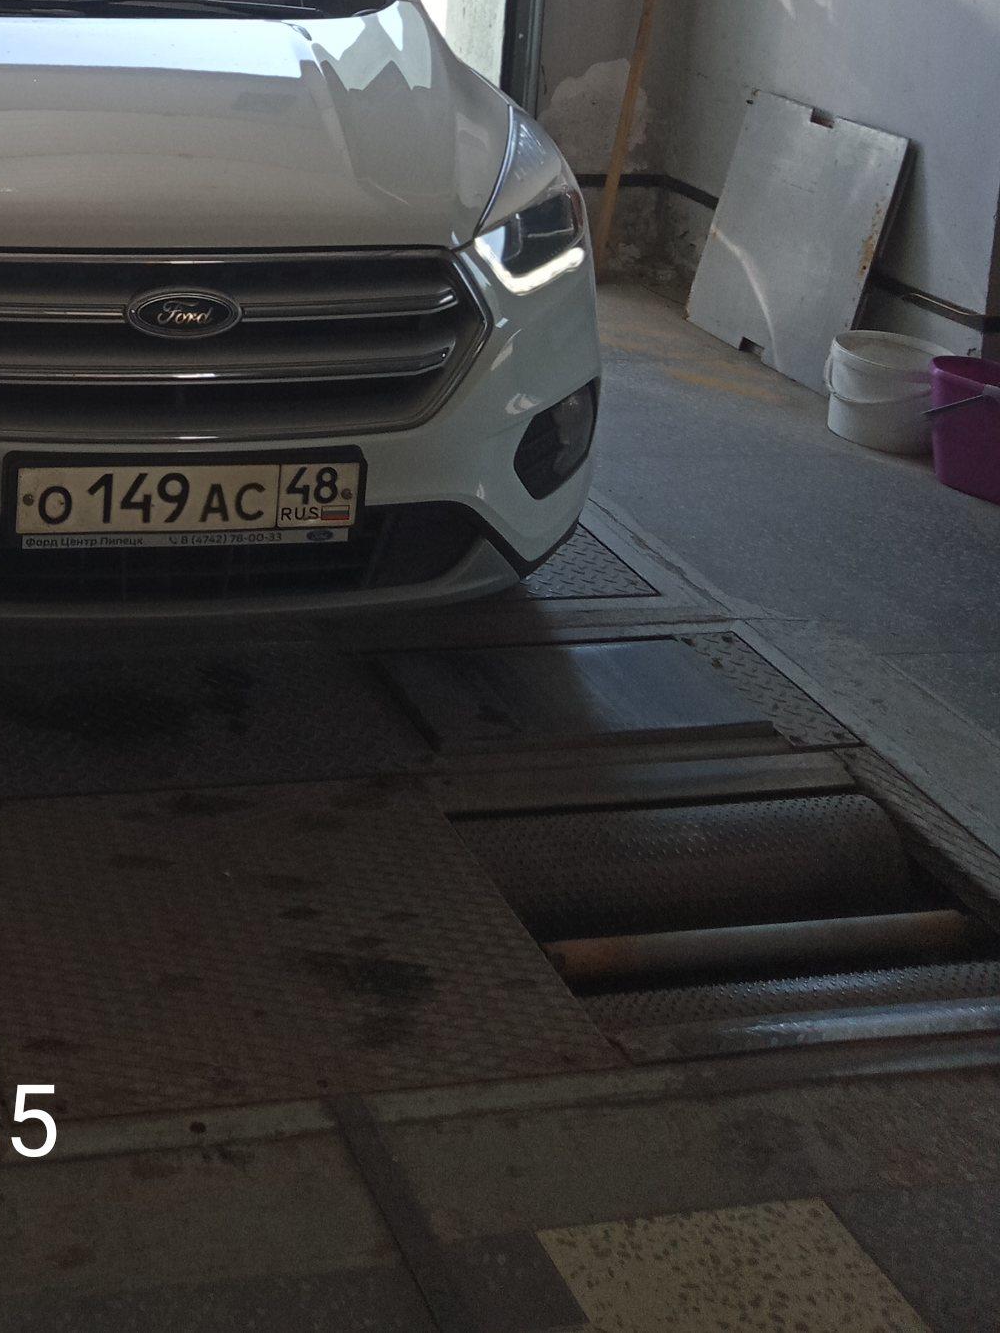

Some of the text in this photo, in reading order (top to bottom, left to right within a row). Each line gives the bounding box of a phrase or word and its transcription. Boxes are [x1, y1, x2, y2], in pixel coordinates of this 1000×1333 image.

[157, 300, 213, 325] Ford
[286, 466, 339, 505] 48
[280, 506, 319, 522] RUS
[61, 537, 98, 547] Центр
[100, 536, 144, 547] Липецк
